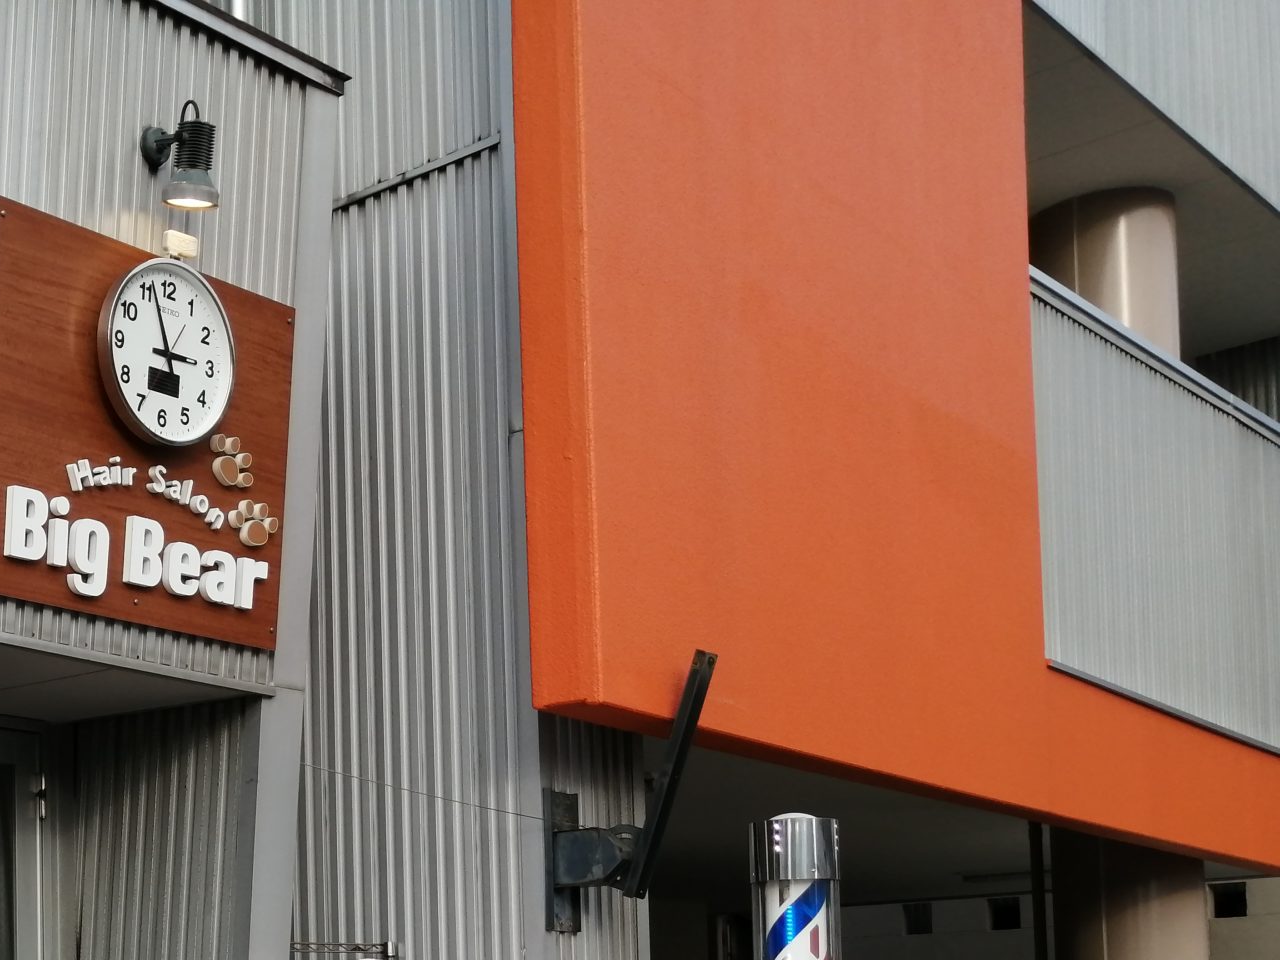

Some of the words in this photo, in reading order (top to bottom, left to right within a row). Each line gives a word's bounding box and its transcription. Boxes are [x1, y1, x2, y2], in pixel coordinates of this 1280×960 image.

[139, 281, 153, 302] 11
[161, 280, 177, 301] 12
[120, 300, 138, 321] 10
[187, 299, 195, 317] 1
[114, 329, 125, 348] 9
[200, 326, 211, 346] 2
[120, 365, 131, 384] 8
[205, 360, 214, 378] 3
[136, 392, 146, 412] 7
[197, 390, 207, 408] 4
[157, 409, 167, 427] 6
[180, 406, 190, 425] 5
[65, 456, 137, 492] Hair
[146, 464, 225, 530] Salon
[3, 485, 110, 597] Big
[122, 515, 269, 610] Bear
